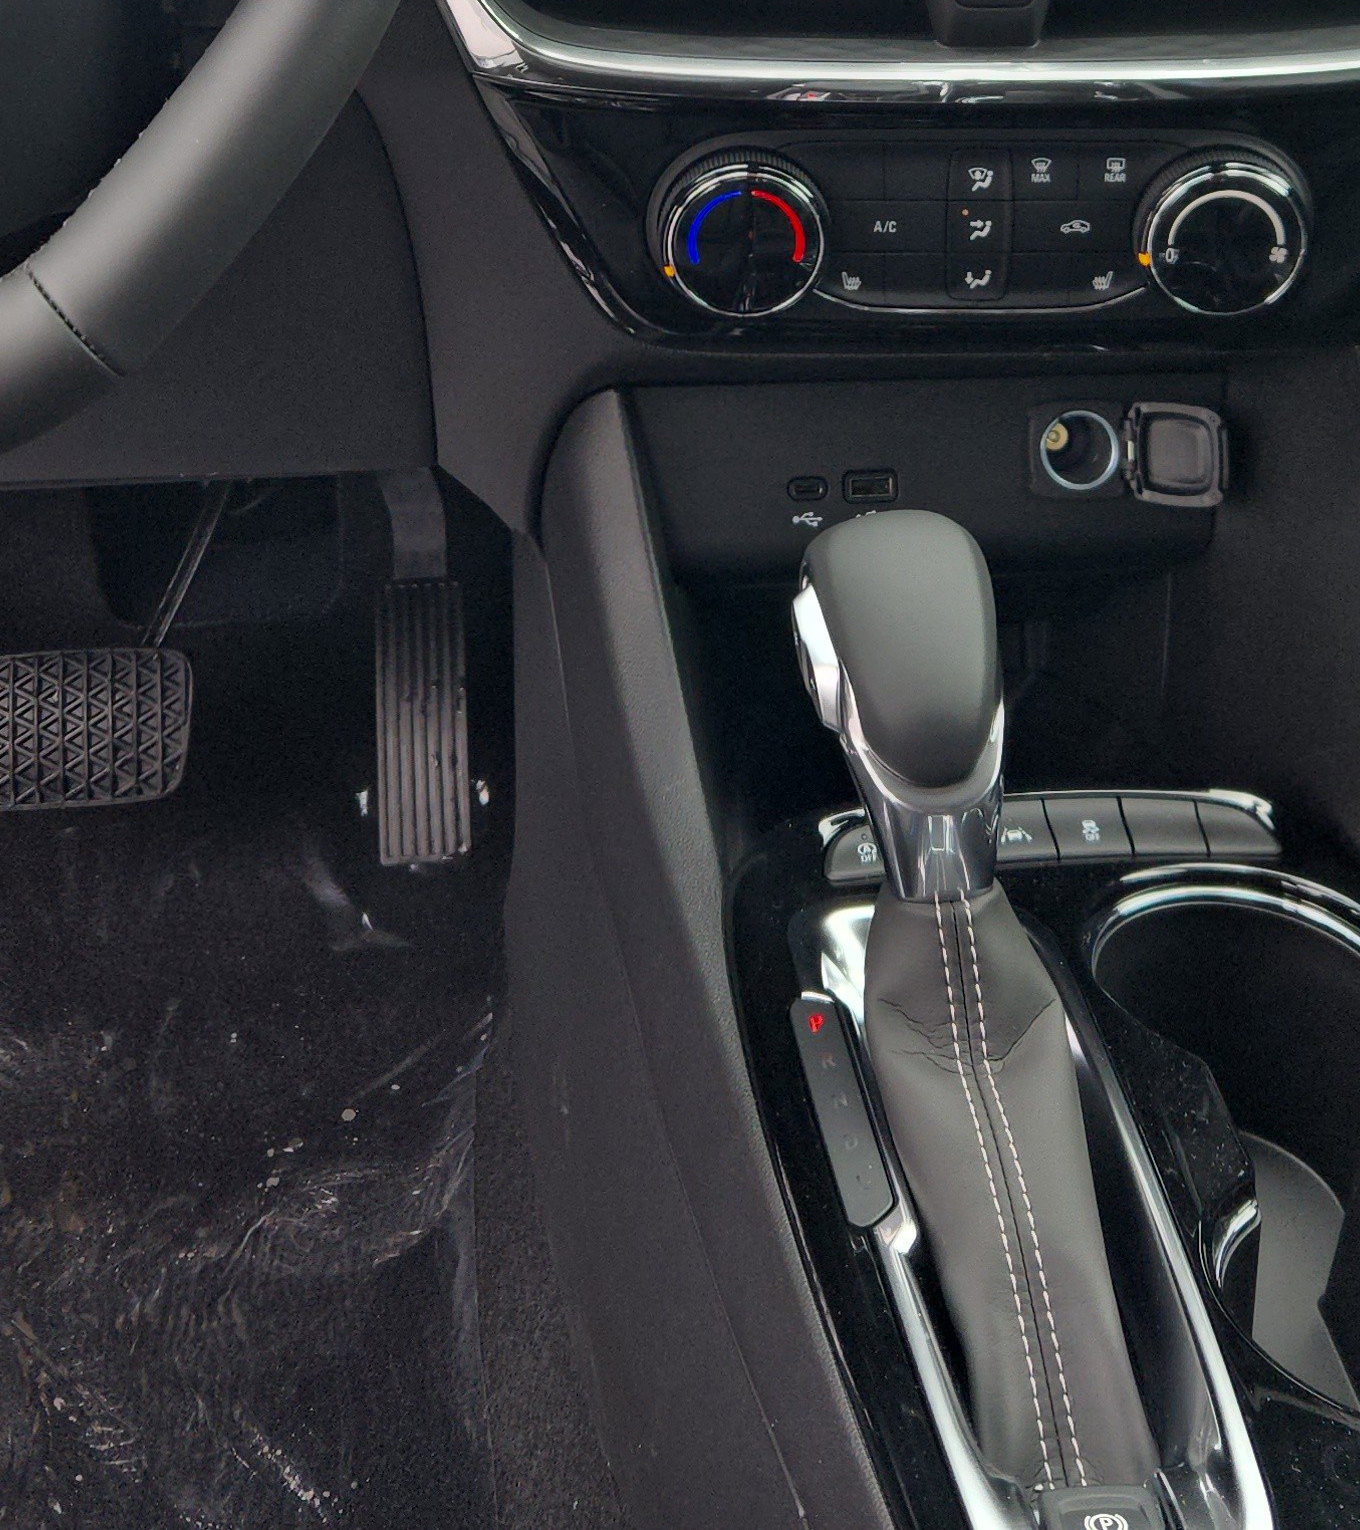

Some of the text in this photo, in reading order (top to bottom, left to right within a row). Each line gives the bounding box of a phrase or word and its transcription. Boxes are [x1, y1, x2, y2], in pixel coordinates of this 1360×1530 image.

[1030, 172, 1052, 184] MAX
[1104, 172, 1127, 184] REAR
[873, 220, 897, 233] A/C
[808, 1012, 825, 1035] P
[821, 1052, 837, 1069] R
